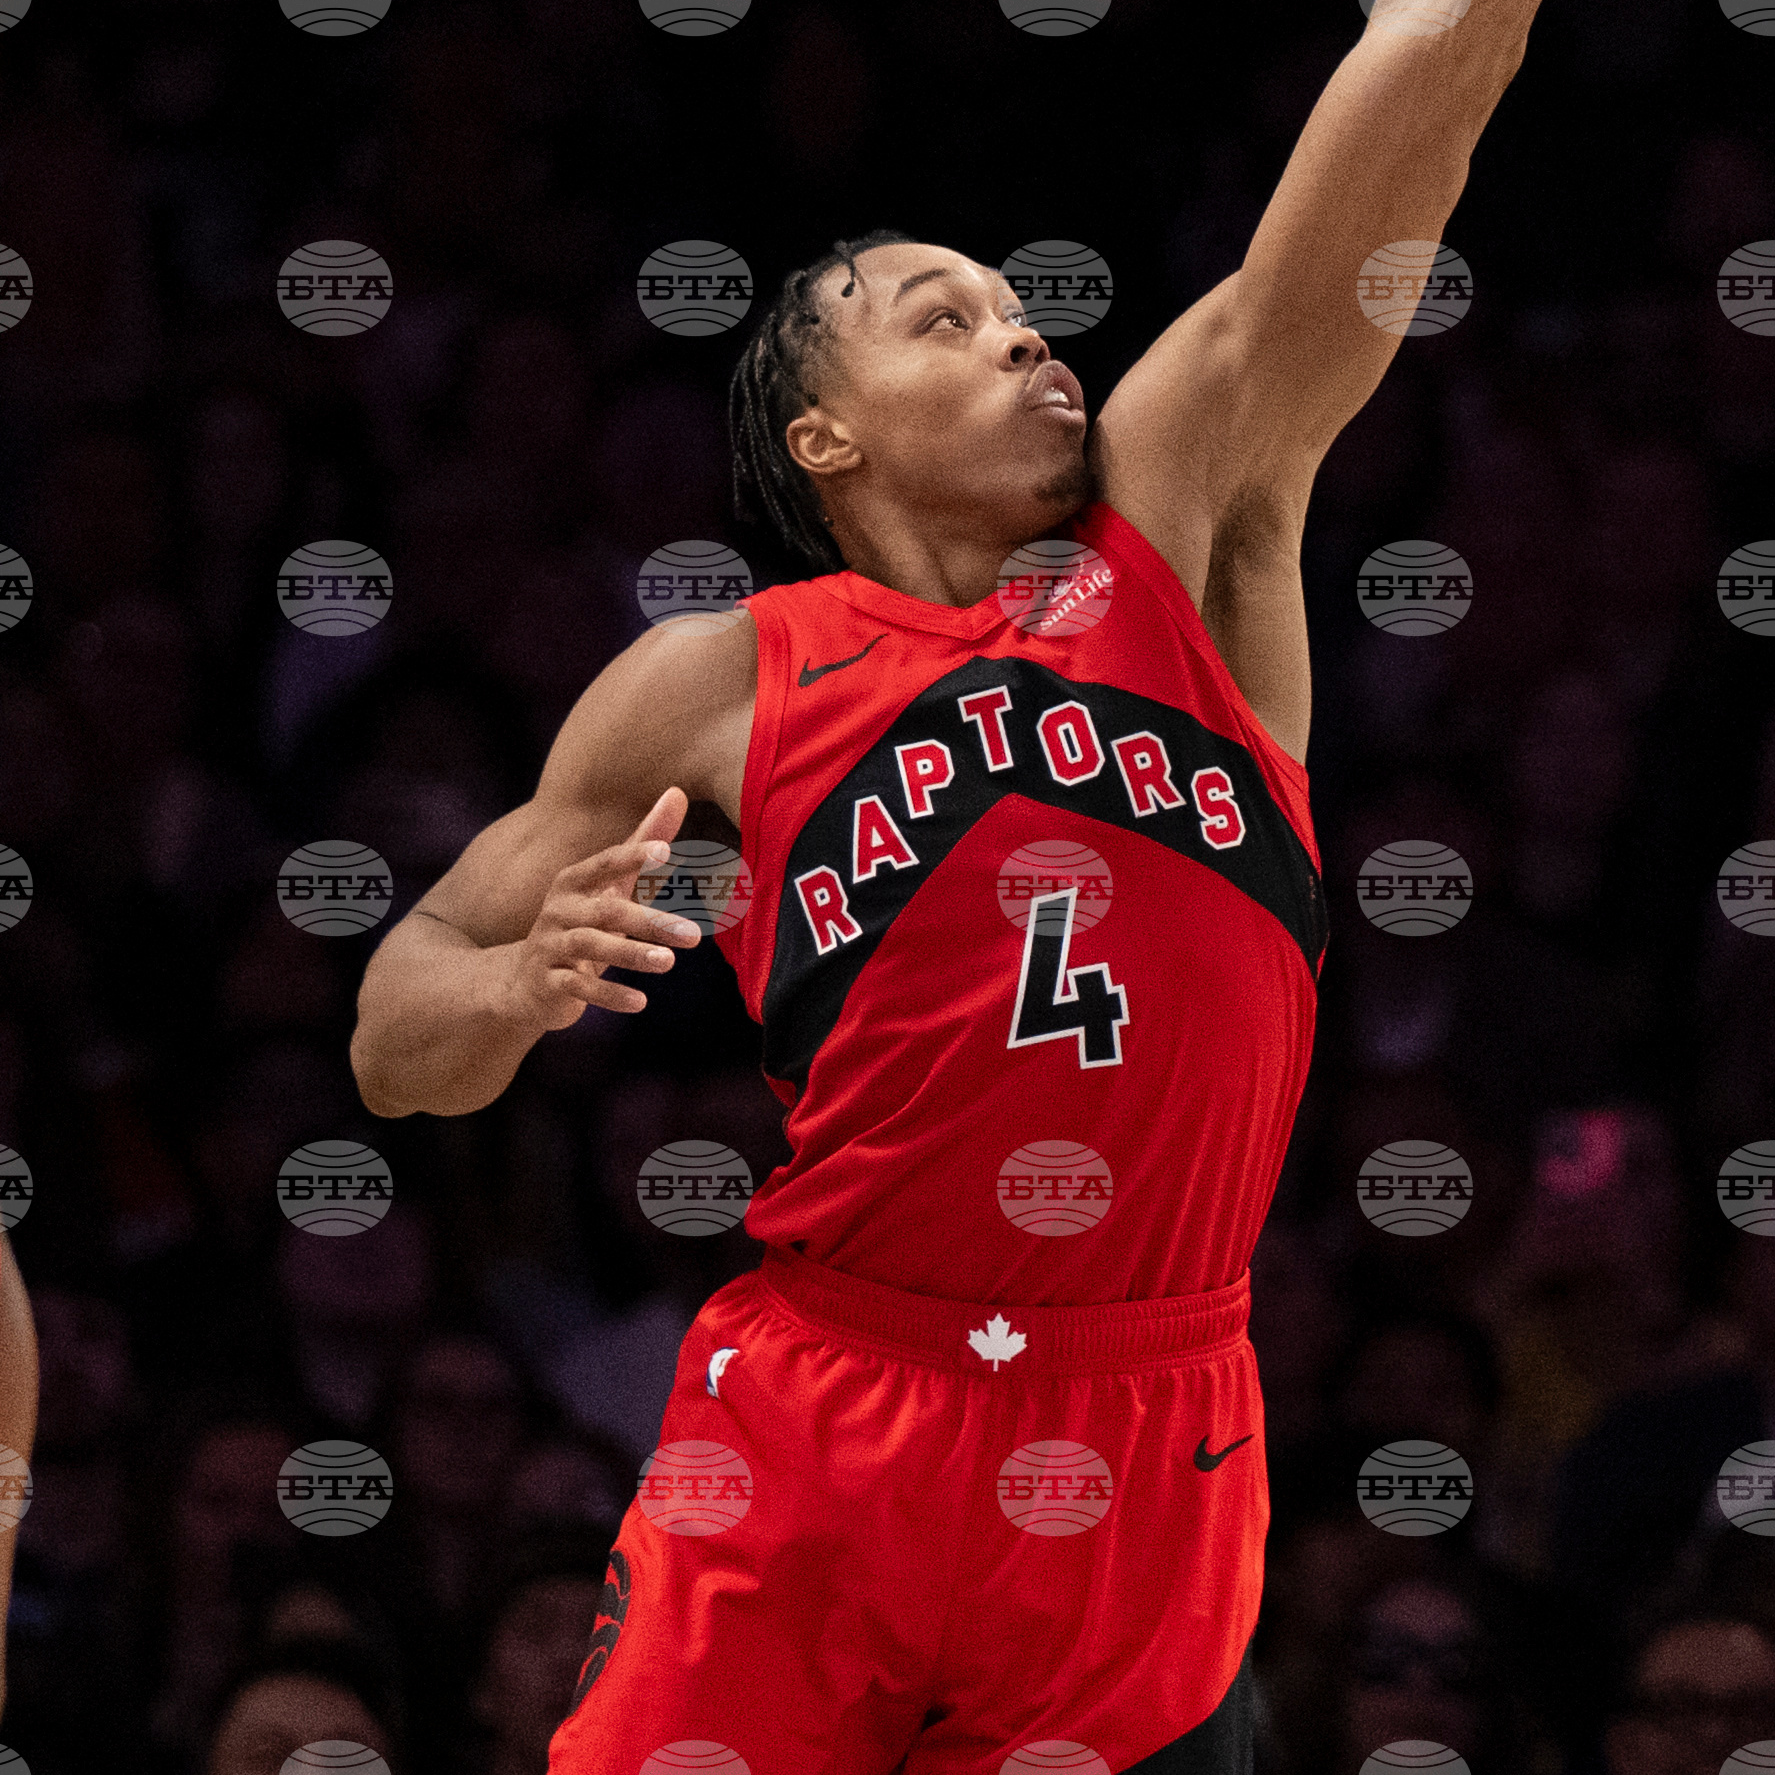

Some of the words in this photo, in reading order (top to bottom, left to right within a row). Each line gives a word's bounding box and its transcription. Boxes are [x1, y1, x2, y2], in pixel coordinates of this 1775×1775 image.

[1040, 598, 1077, 631] Sun
[1075, 569, 1114, 600] Life
[795, 685, 1246, 956] RAPTORS
[1007, 886, 1131, 1070] 4
